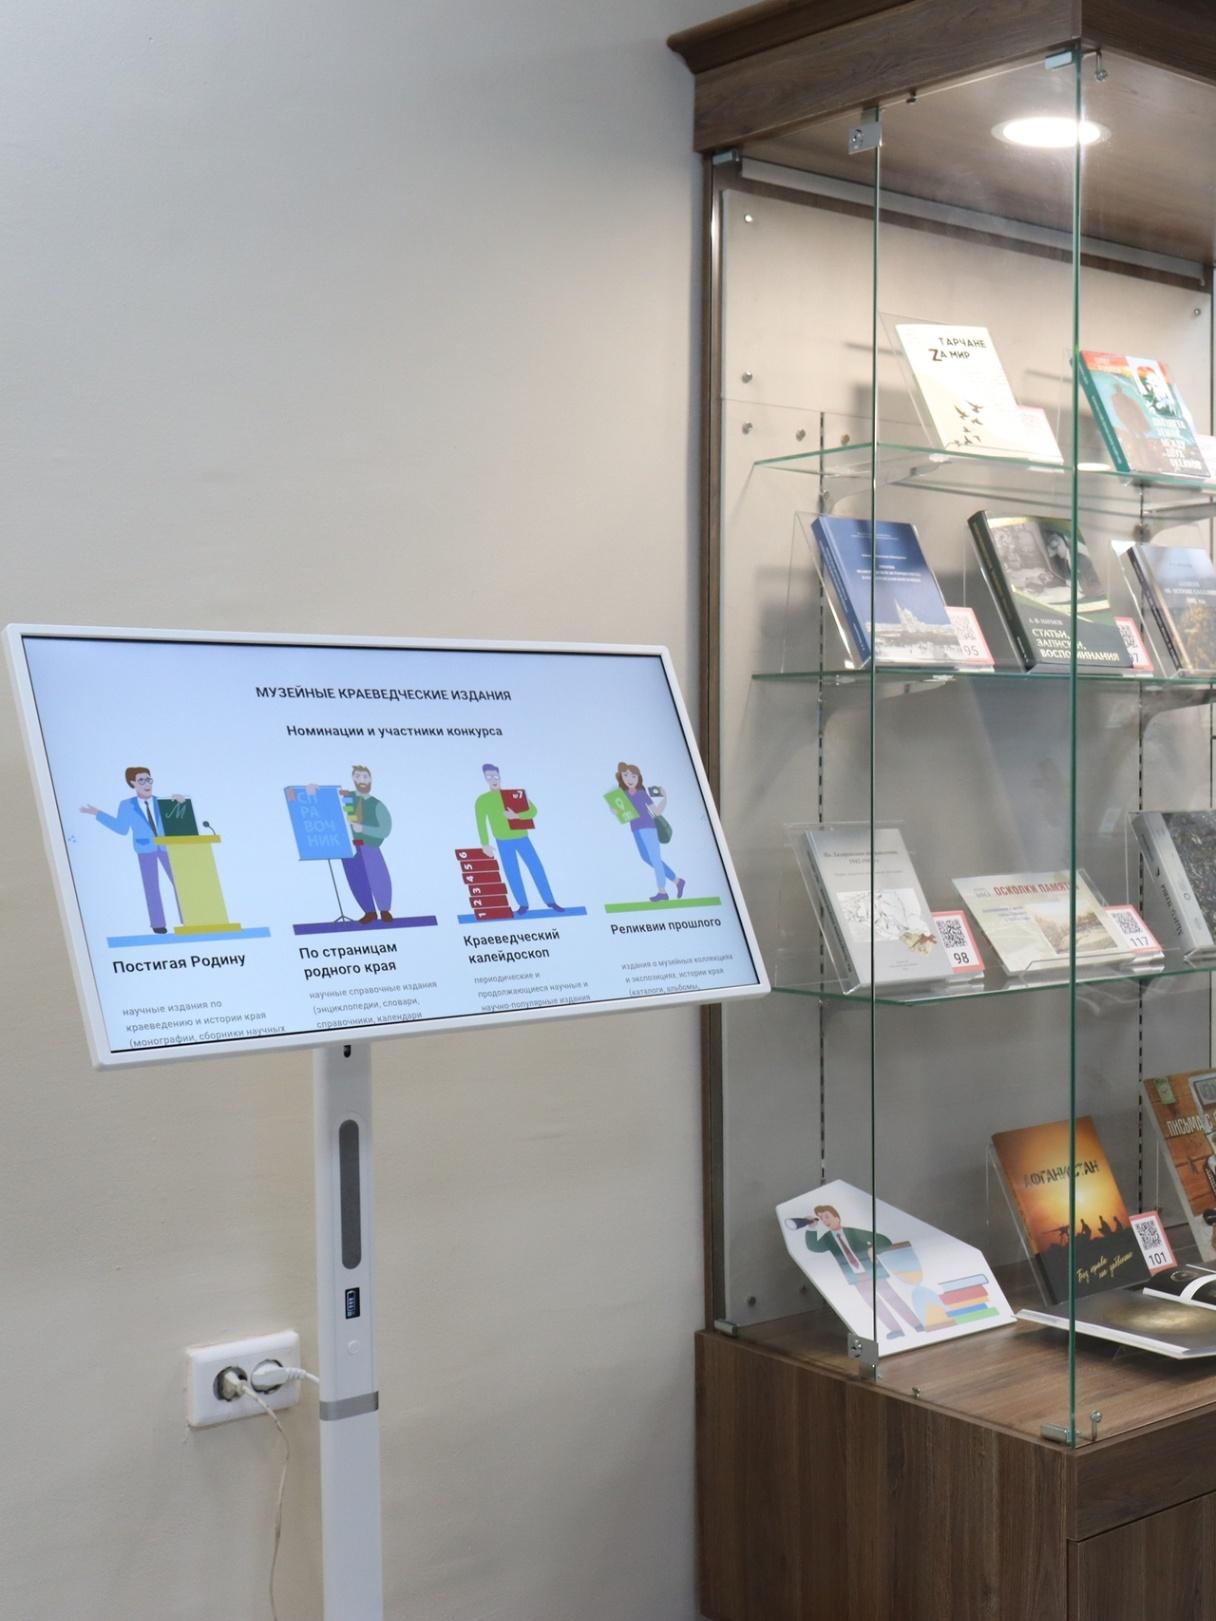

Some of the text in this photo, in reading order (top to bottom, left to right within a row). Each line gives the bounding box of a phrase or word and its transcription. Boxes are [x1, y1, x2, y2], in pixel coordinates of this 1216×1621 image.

[950, 351, 970, 359] МИР
[255, 685, 512, 703] МУЗЕЙНЫЕ КРАЕВЕДЧЕСКИЕ ИЗДАНИЯ
[286, 725, 503, 740] Номинации и участники конкурса
[610, 918, 722, 935] Реликвии прошлого
[463, 928, 561, 948] Краеведческий
[1129, 936, 1149, 946] 117
[299, 943, 398, 960] По страницам
[468, 948, 550, 964] калейдоскоп
[953, 952, 970, 965] 98
[112, 954, 246, 974] Постигая Родину
[303, 961, 396, 980] родного края
[474, 973, 534, 985] периодические
[679, 970, 707, 979] истории
[708, 968, 724, 976] края
[309, 981, 438, 1000] научные справочные издания
[478, 985, 549, 998] продолжающиеся
[550, 982, 582, 992] научные
[313, 998, 420, 1015] (энциклопедии, словари,
[559, 994, 591, 1005] издания
[122, 1000, 222, 1018] научные издания по
[126, 1012, 267, 1032] краеведению и истории края
[316, 1011, 423, 1029] справочники, календари
[129, 1025, 286, 1048] (монографии, сборники научных
[1166, 1112, 1205, 1137] ПИСЬМА
[1205, 1112, 1213, 1129] С
[1149, 1252, 1168, 1267] 101
